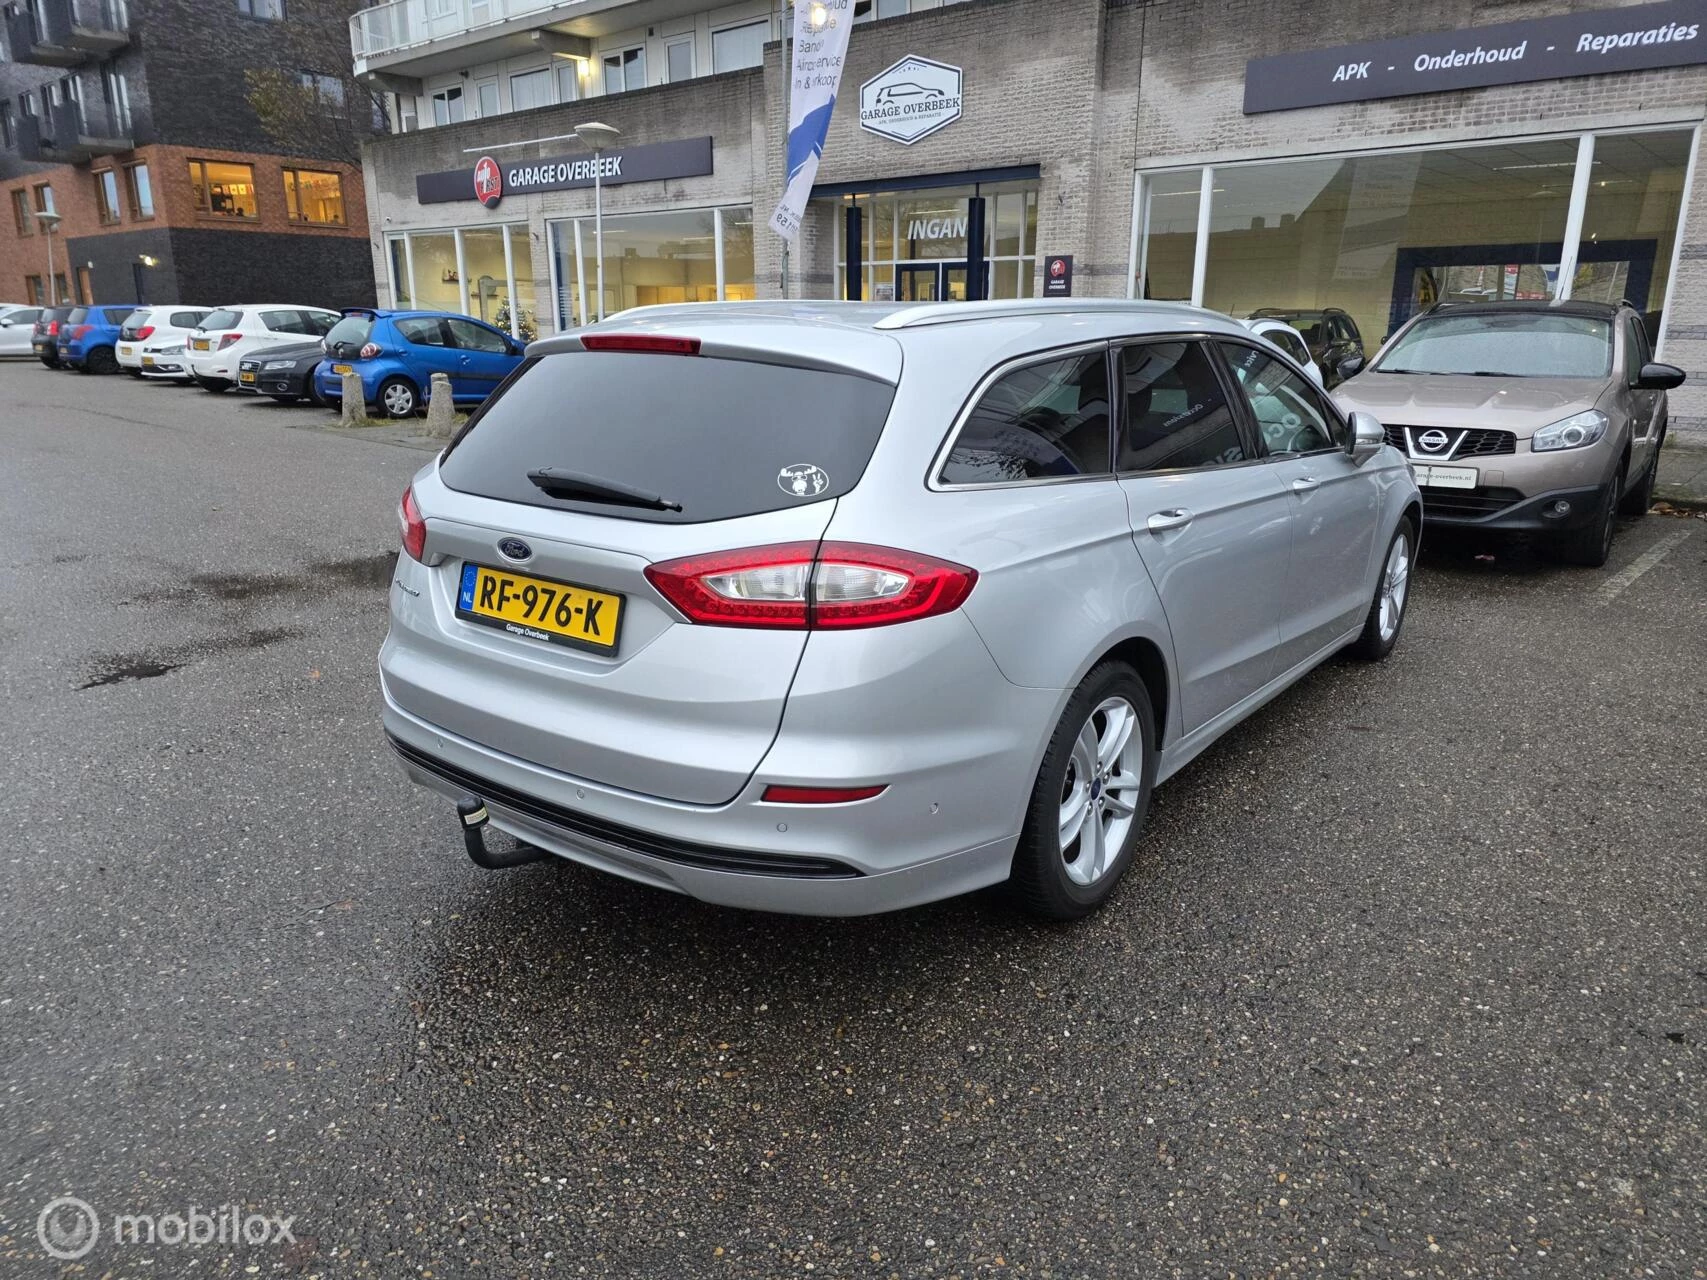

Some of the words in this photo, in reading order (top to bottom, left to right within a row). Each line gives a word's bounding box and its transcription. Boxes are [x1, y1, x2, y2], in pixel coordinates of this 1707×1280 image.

[1332, 61, 1372, 82] APK
[1414, 40, 1527, 71] Onderhoud
[1576, 22, 1699, 54] Reparaties
[861, 106, 900, 120] GARAGE
[903, 97, 960, 114] OVERBEEK
[509, 164, 556, 187] GARAGE
[557, 155, 622, 182] OVERBEEK
[907, 217, 967, 240] INGAN
[462, 591, 473, 603] NL
[479, 575, 604, 636] RF-976-K
[506, 623, 525, 636] Garage
[524, 628, 550, 641] Overbeek
